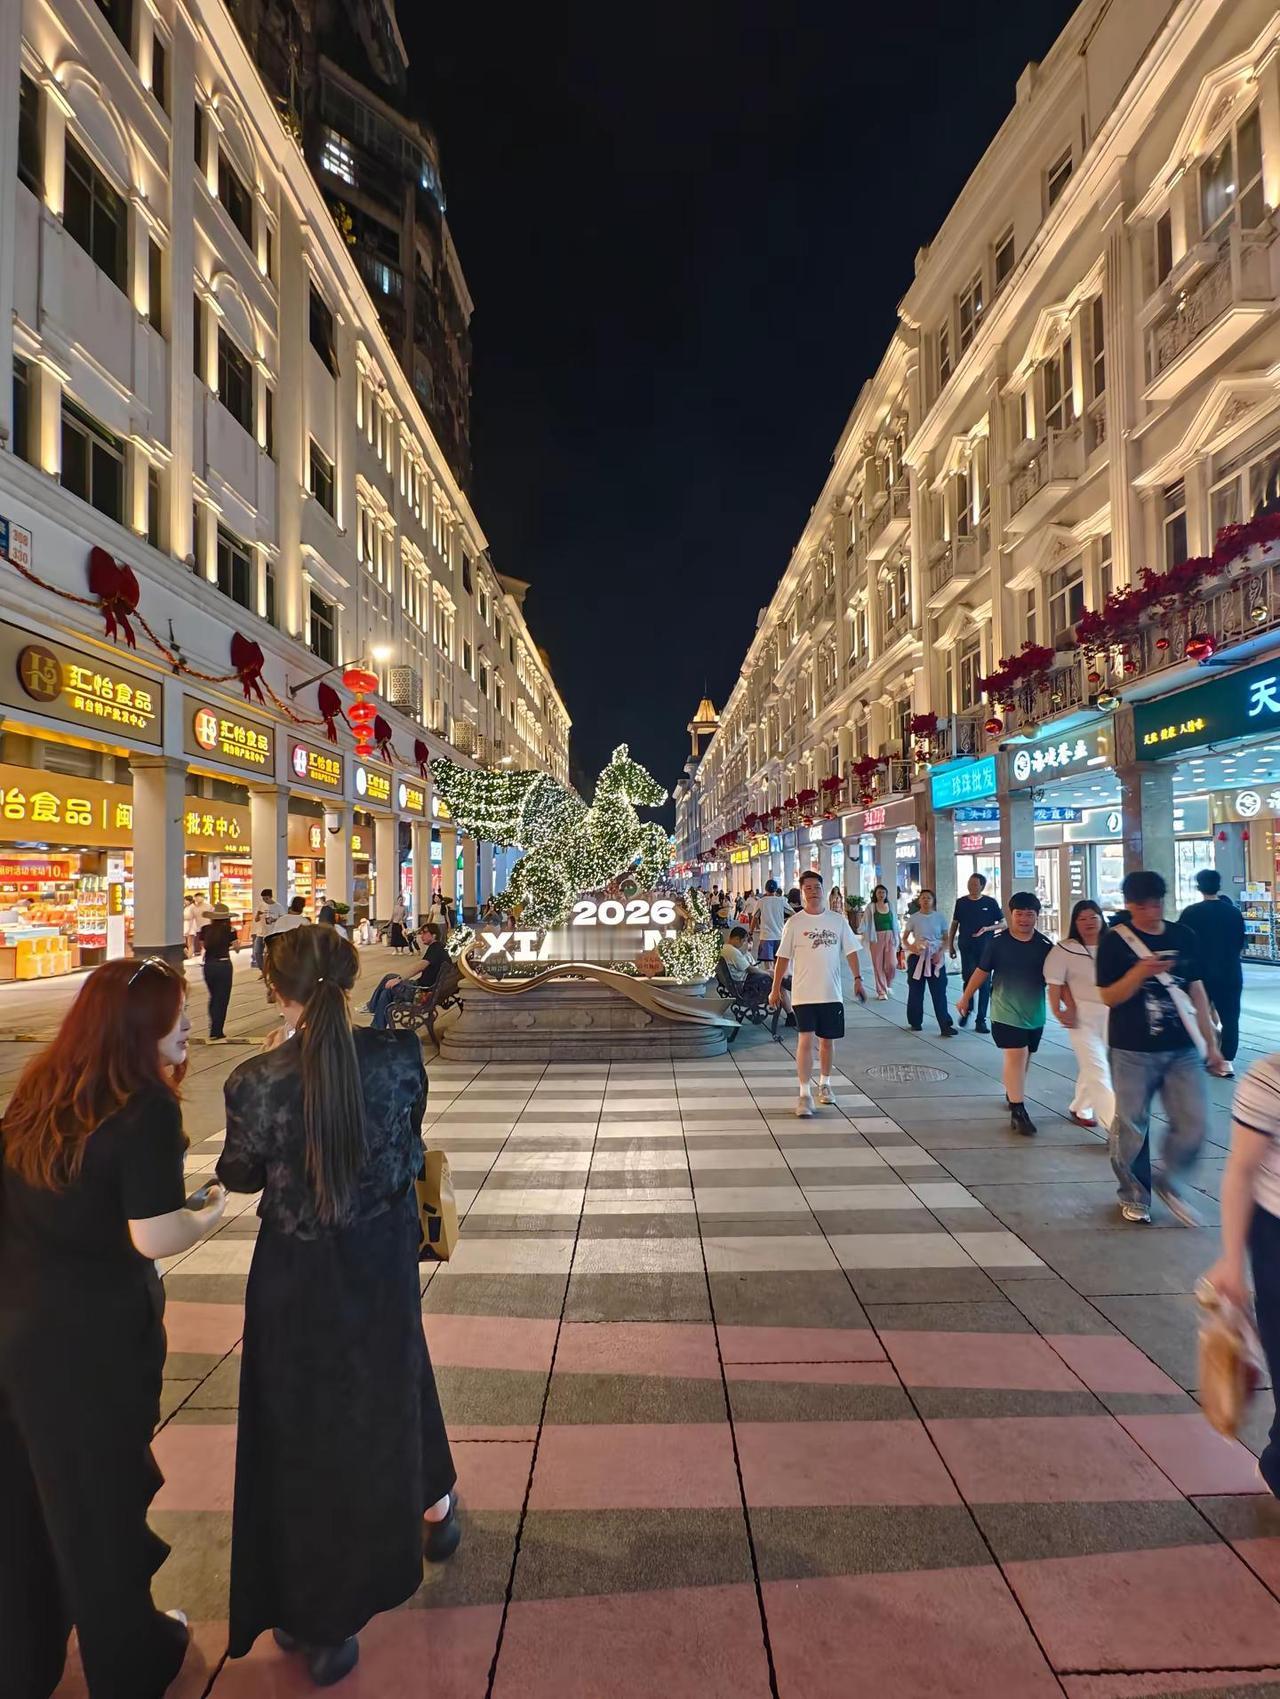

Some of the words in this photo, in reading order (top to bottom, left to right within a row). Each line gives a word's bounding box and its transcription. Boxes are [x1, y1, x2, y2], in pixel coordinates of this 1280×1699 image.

[69, 665, 152, 711] 汇怡食品
[220, 720, 268, 751] 汇怡食品
[951, 768, 993, 796] 珍珠批发
[186, 812, 241, 839] 批发中心
[572, 900, 675, 926] 2026
